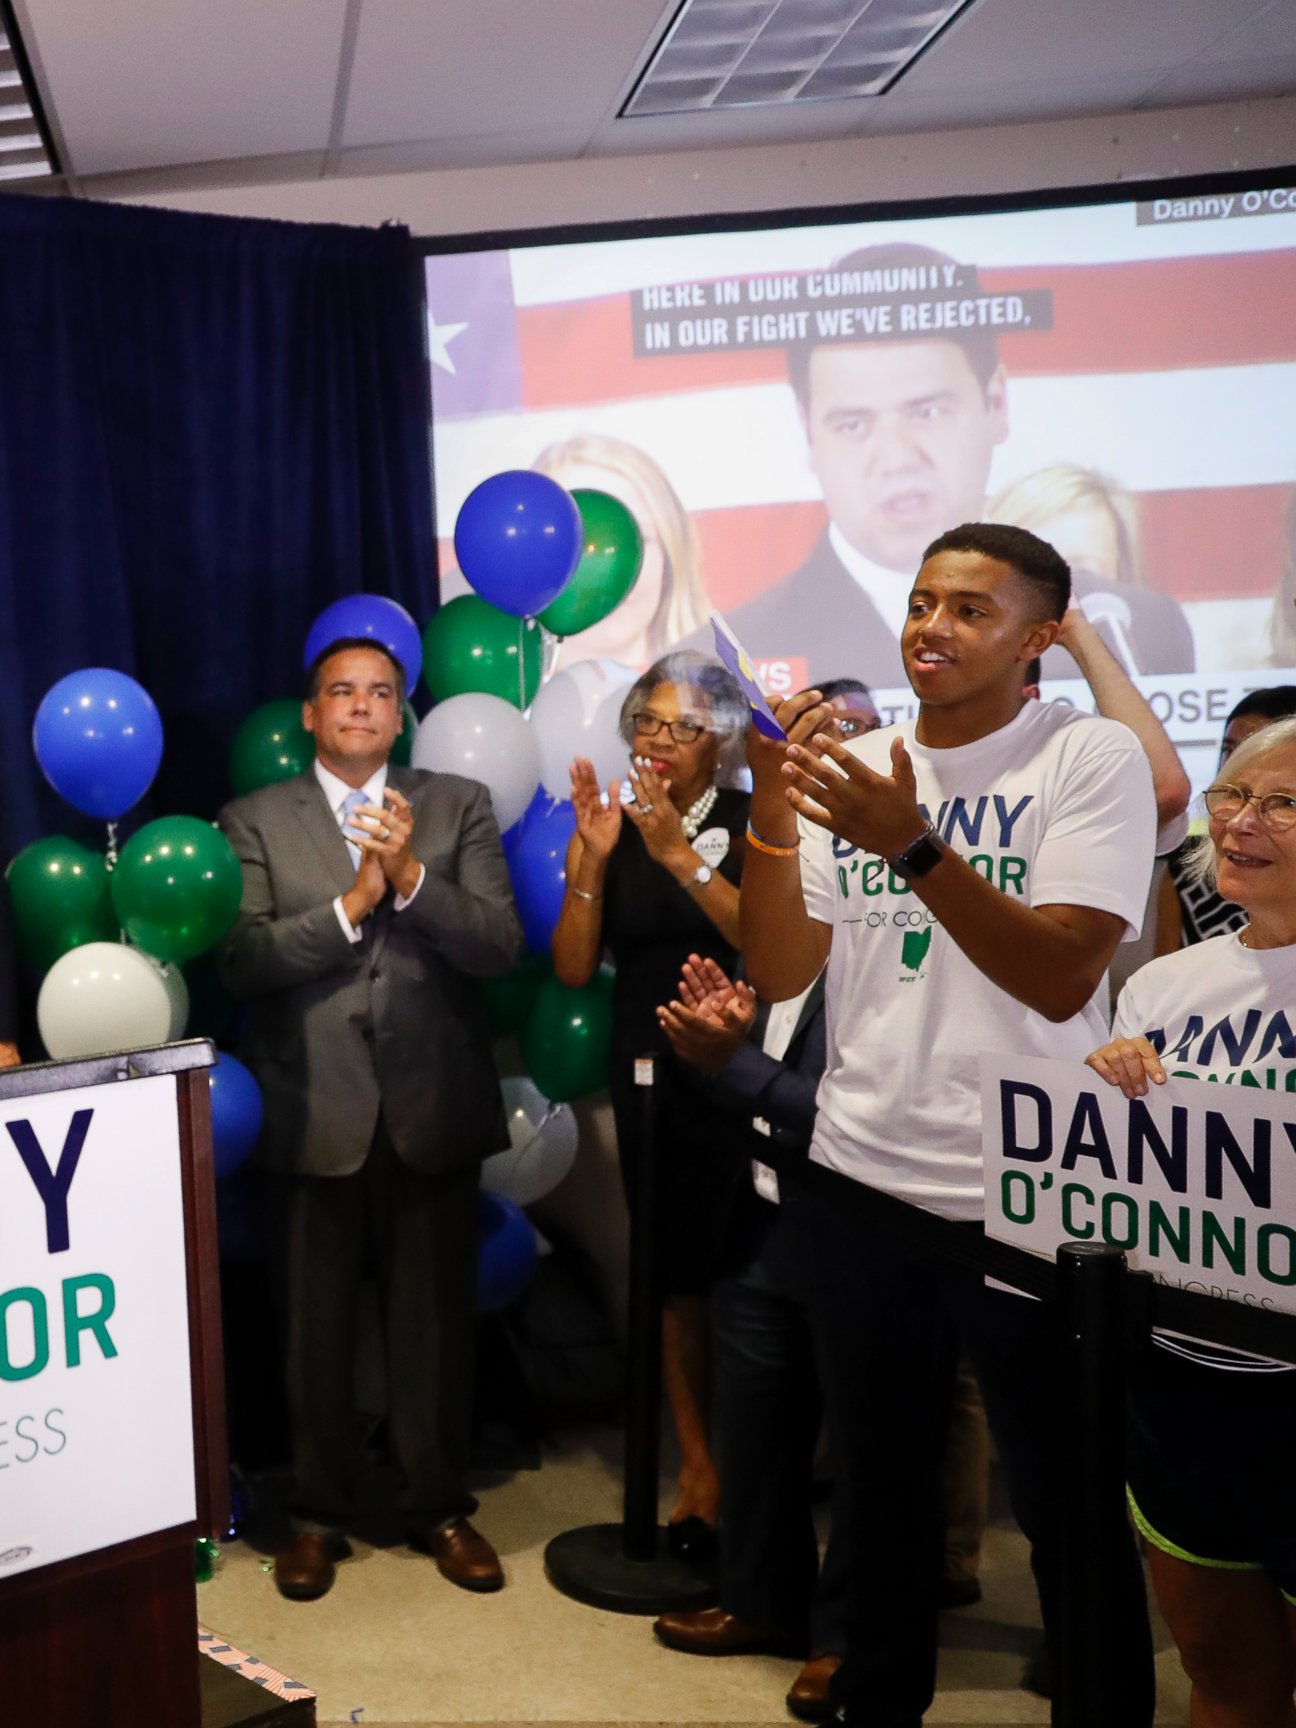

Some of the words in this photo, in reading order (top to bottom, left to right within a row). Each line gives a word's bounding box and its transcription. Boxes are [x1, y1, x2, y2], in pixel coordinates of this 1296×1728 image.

[1153, 197, 1234, 220] Danny
[642, 284, 706, 310] HERE
[714, 281, 741, 305] IN
[748, 276, 799, 302] OUR
[645, 321, 671, 350] IN
[678, 317, 728, 348] OUR
[736, 311, 810, 344] FIGHT
[816, 305, 893, 337] WE'VE
[900, 295, 1032, 332] REJECTED,
